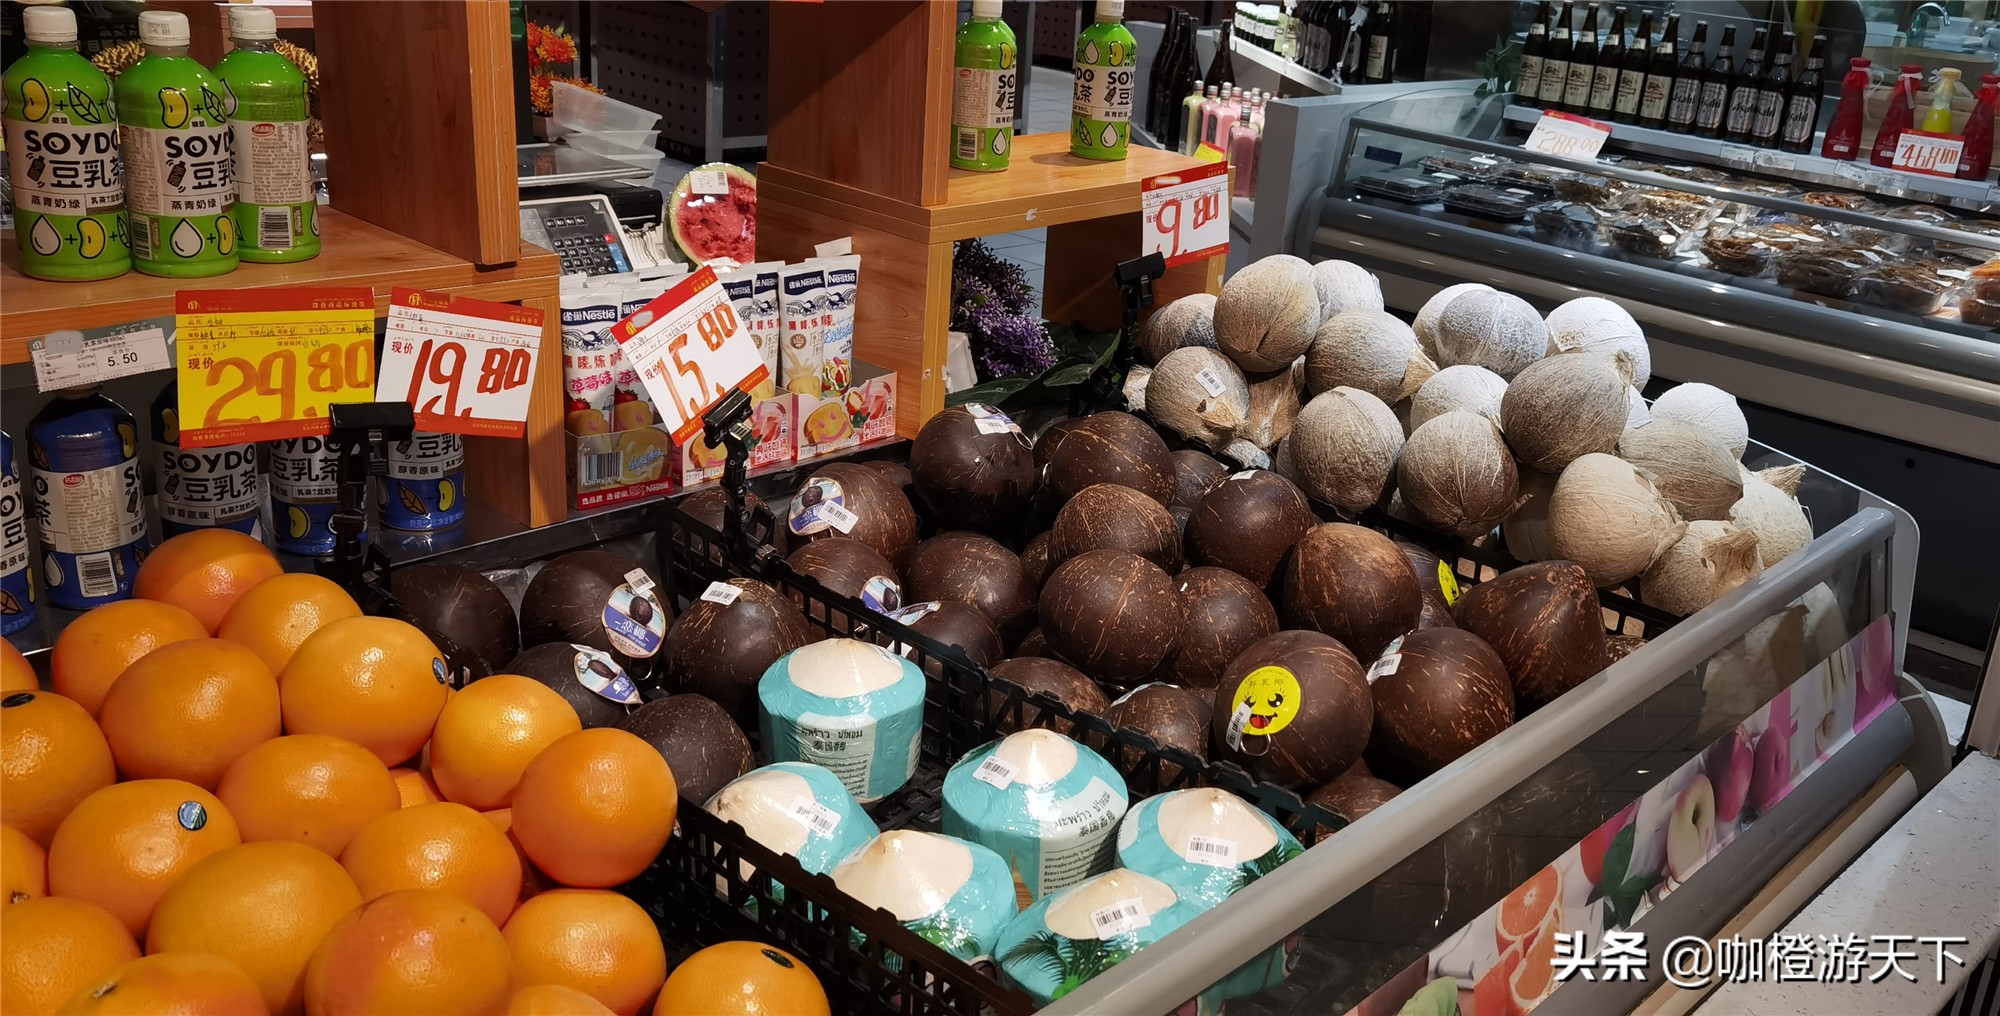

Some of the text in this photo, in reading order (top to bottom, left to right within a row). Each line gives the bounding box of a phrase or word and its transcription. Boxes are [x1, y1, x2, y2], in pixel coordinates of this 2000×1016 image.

[31, 195, 81, 209] 蒸青奶绿
[171, 198, 217, 210] 蒸青奶绿
[391, 341, 414, 355] 现价
[107, 351, 139, 368] 5.50
[187, 356, 215, 369] 现价
[162, 444, 255, 474] SOYDO
[398, 465, 440, 475] 醇香原味
